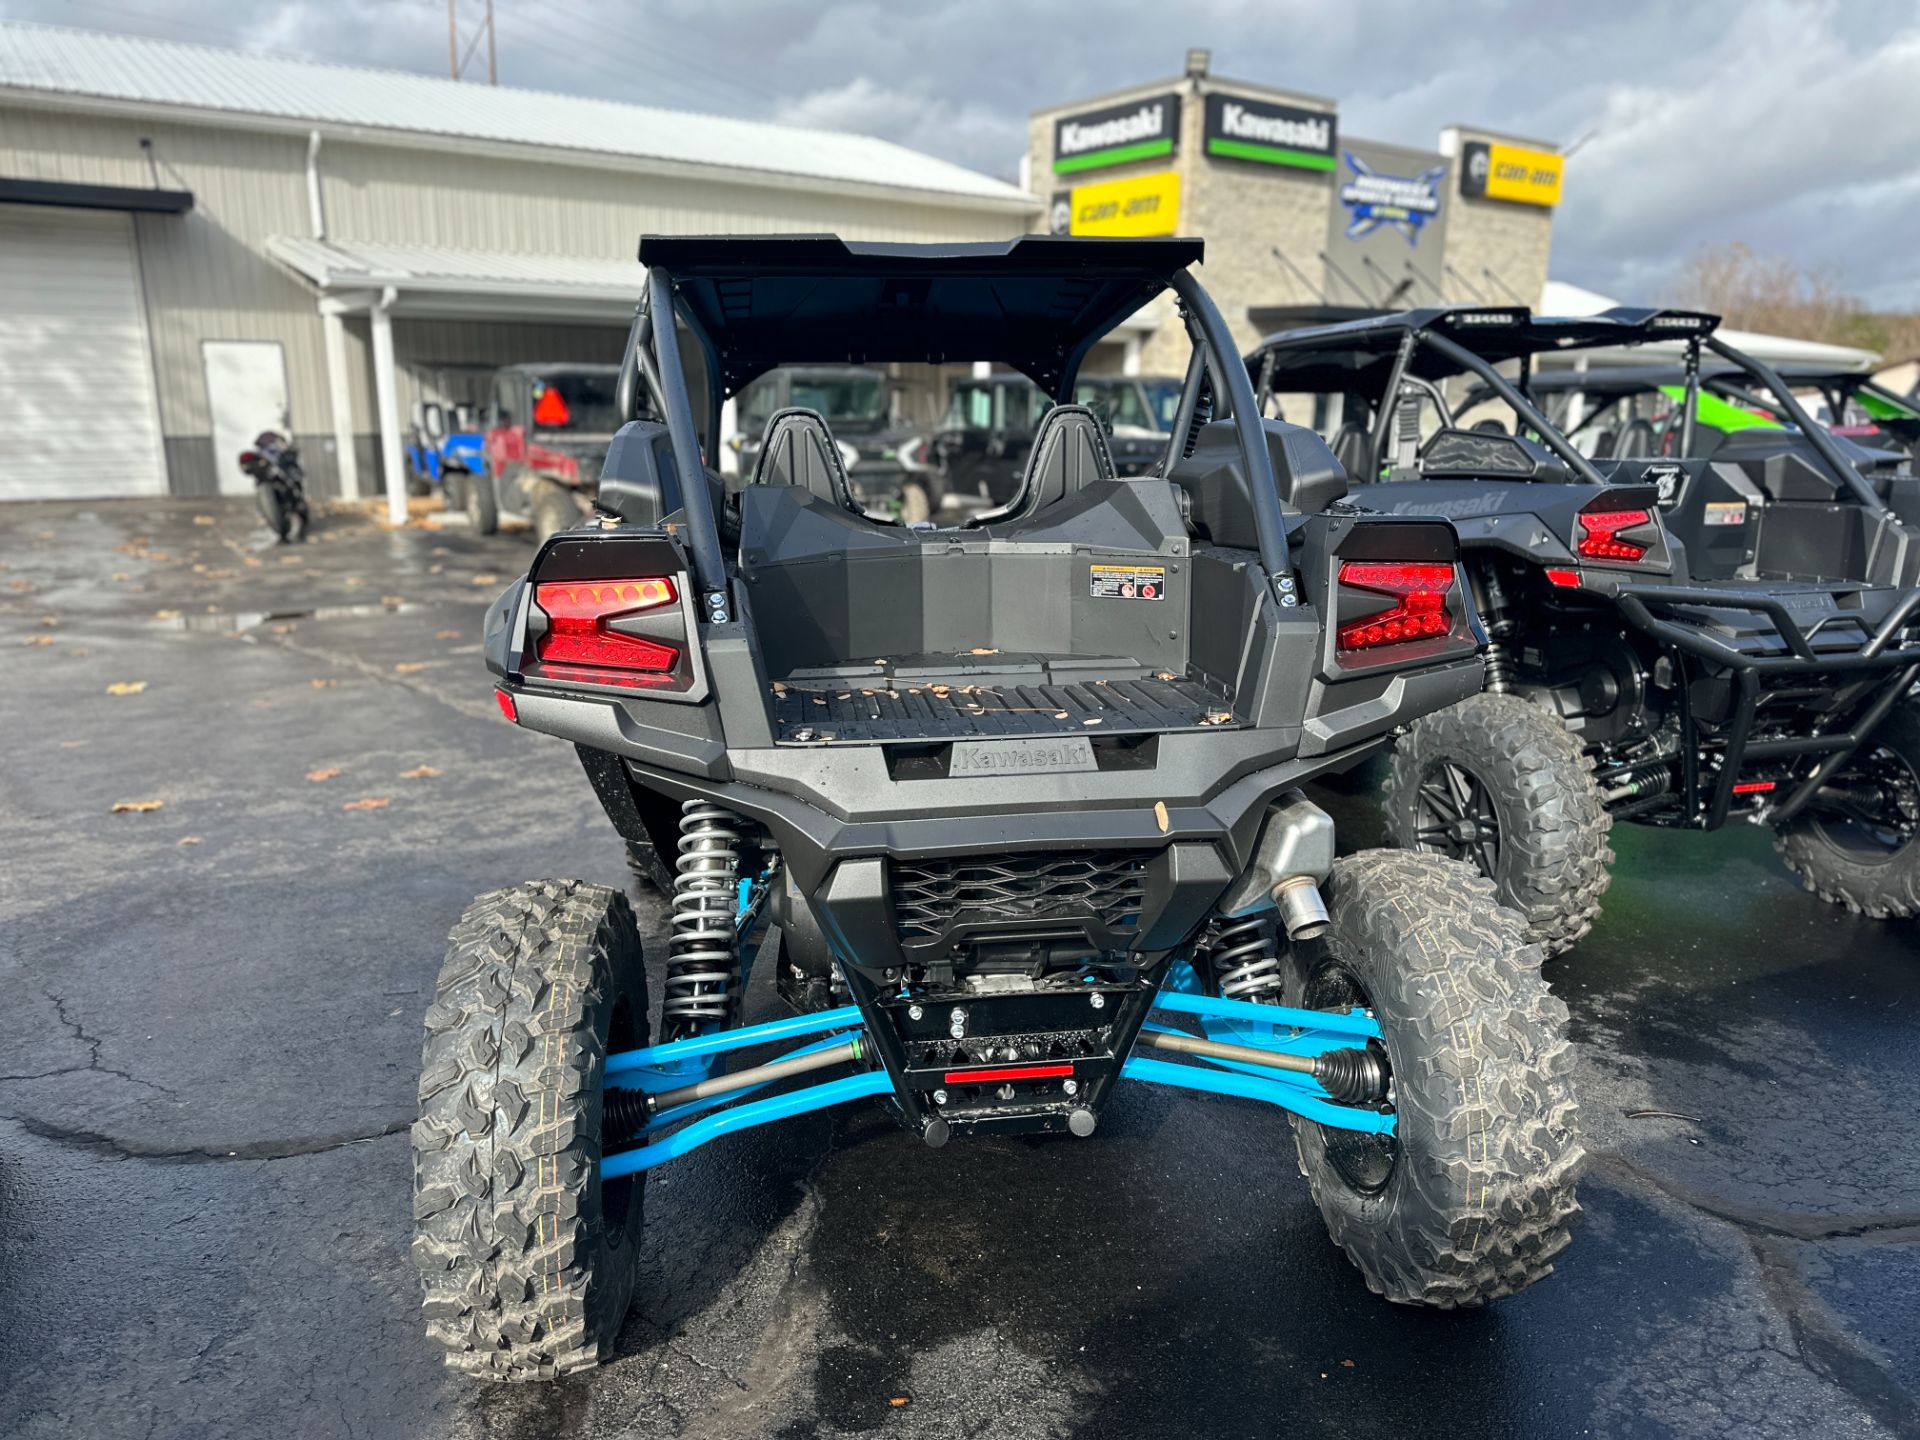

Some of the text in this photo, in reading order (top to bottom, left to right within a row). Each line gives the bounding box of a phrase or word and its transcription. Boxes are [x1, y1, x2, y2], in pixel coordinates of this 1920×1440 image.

[1060, 104, 1163, 153] Kawasaki
[1222, 103, 1330, 150] Kawasaki
[1393, 490, 1509, 517] Kawasaki
[960, 743, 1088, 770] Kawasaki
